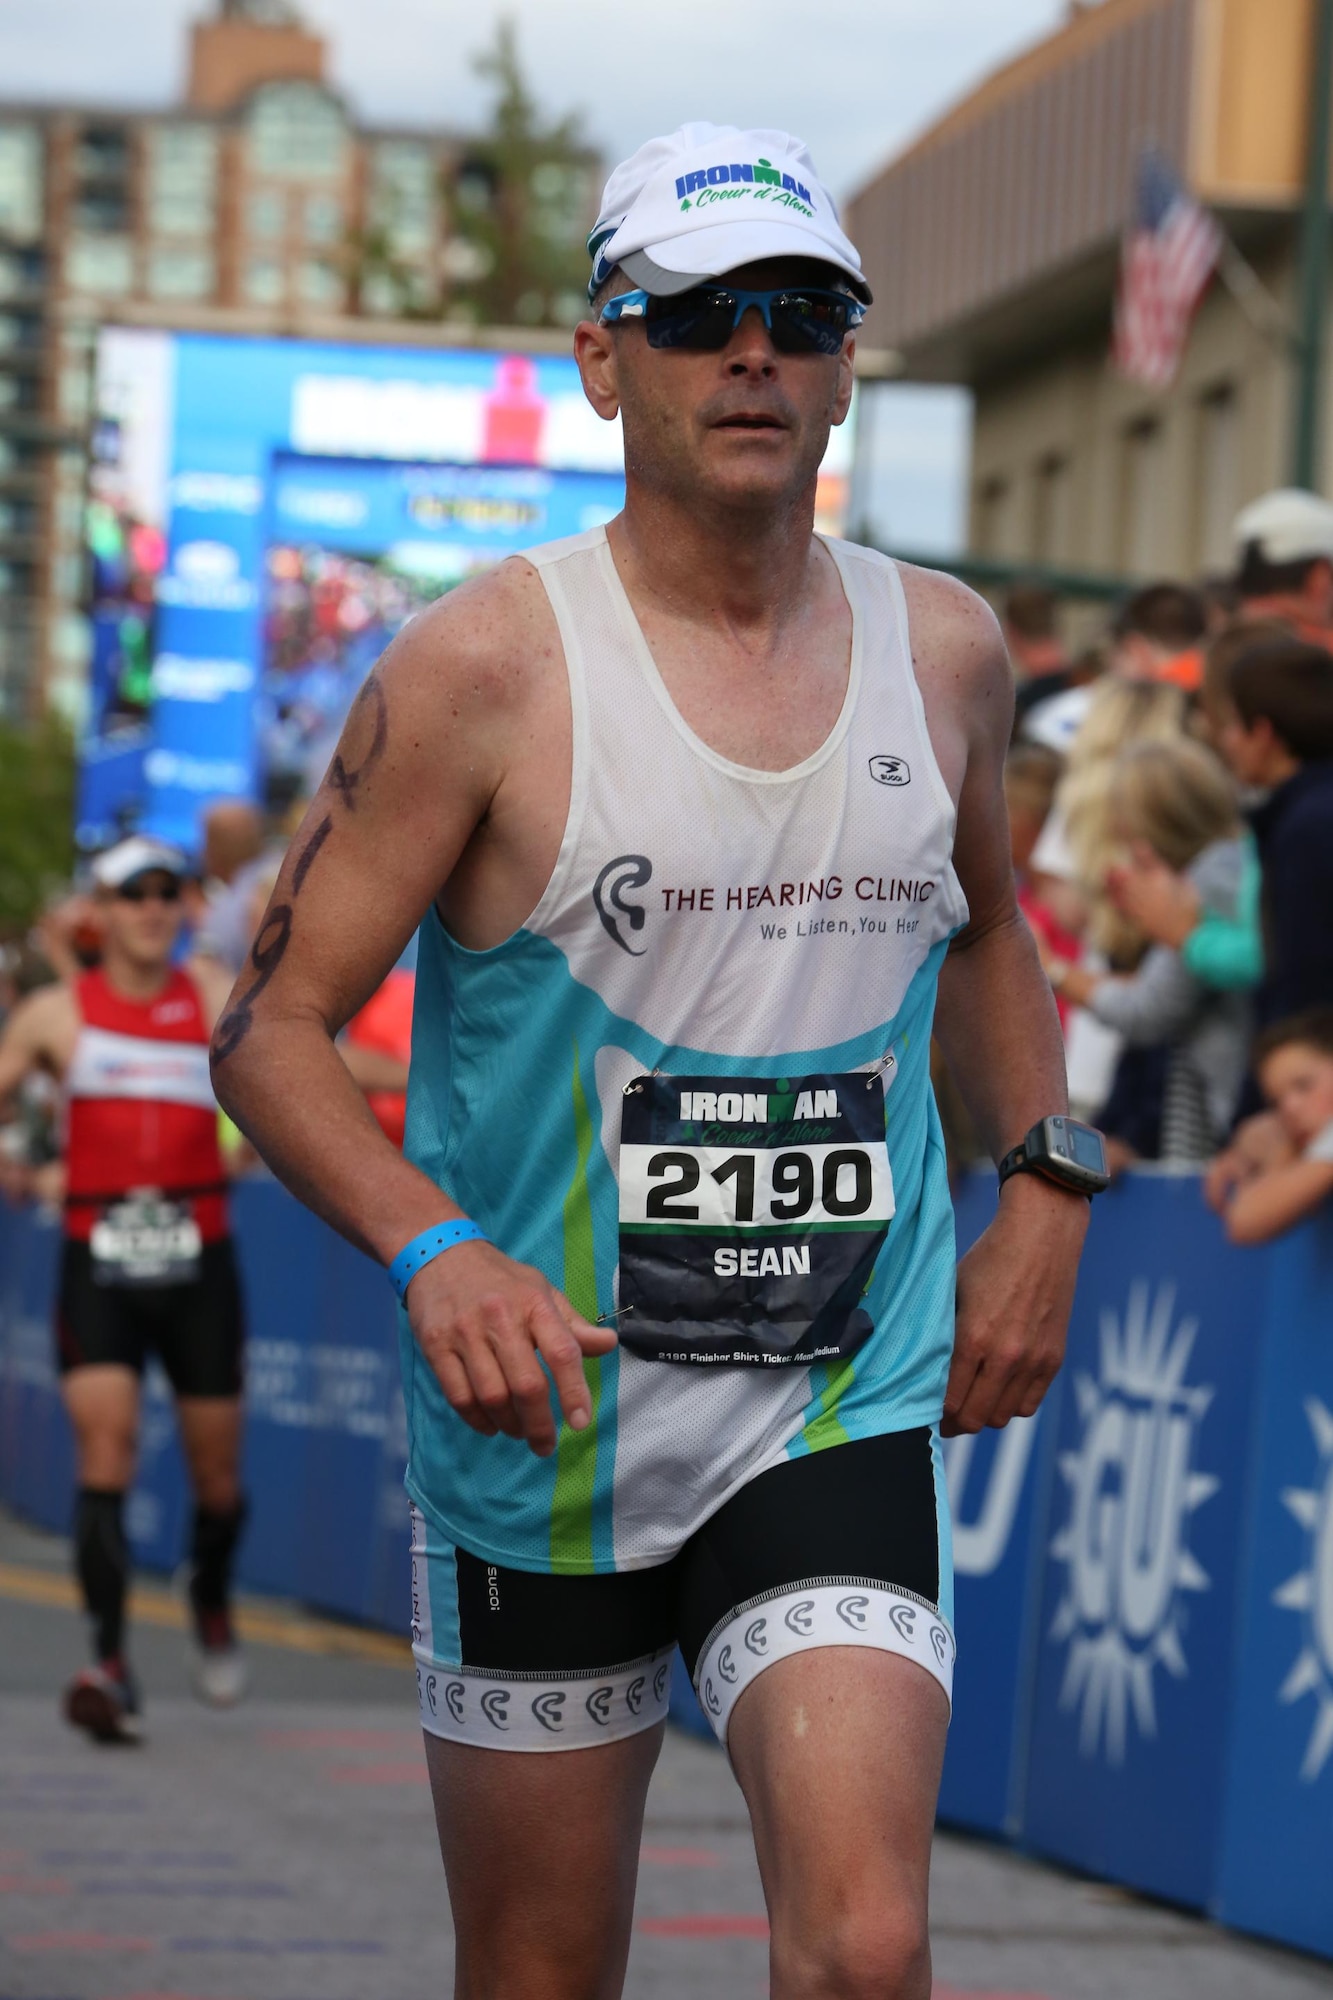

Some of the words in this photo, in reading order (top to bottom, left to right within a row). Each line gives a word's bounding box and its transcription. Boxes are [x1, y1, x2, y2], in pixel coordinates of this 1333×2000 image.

[675, 158, 817, 211] IRONMAN
[696, 188, 752, 208] Coeur
[661, 889, 714, 911] THE
[726, 876, 843, 910] HEARING
[855, 876, 936, 903] CLINIC
[760, 923, 787, 940] We
[896, 918, 920, 934] Hear
[701, 1123, 764, 1145] Coeur
[646, 1149, 872, 1222] 2190
[713, 1246, 811, 1277] SEAN
[658, 1352, 687, 1361] 2190
[690, 1352, 731, 1362] Finisher
[732, 1351, 760, 1362] Shirt
